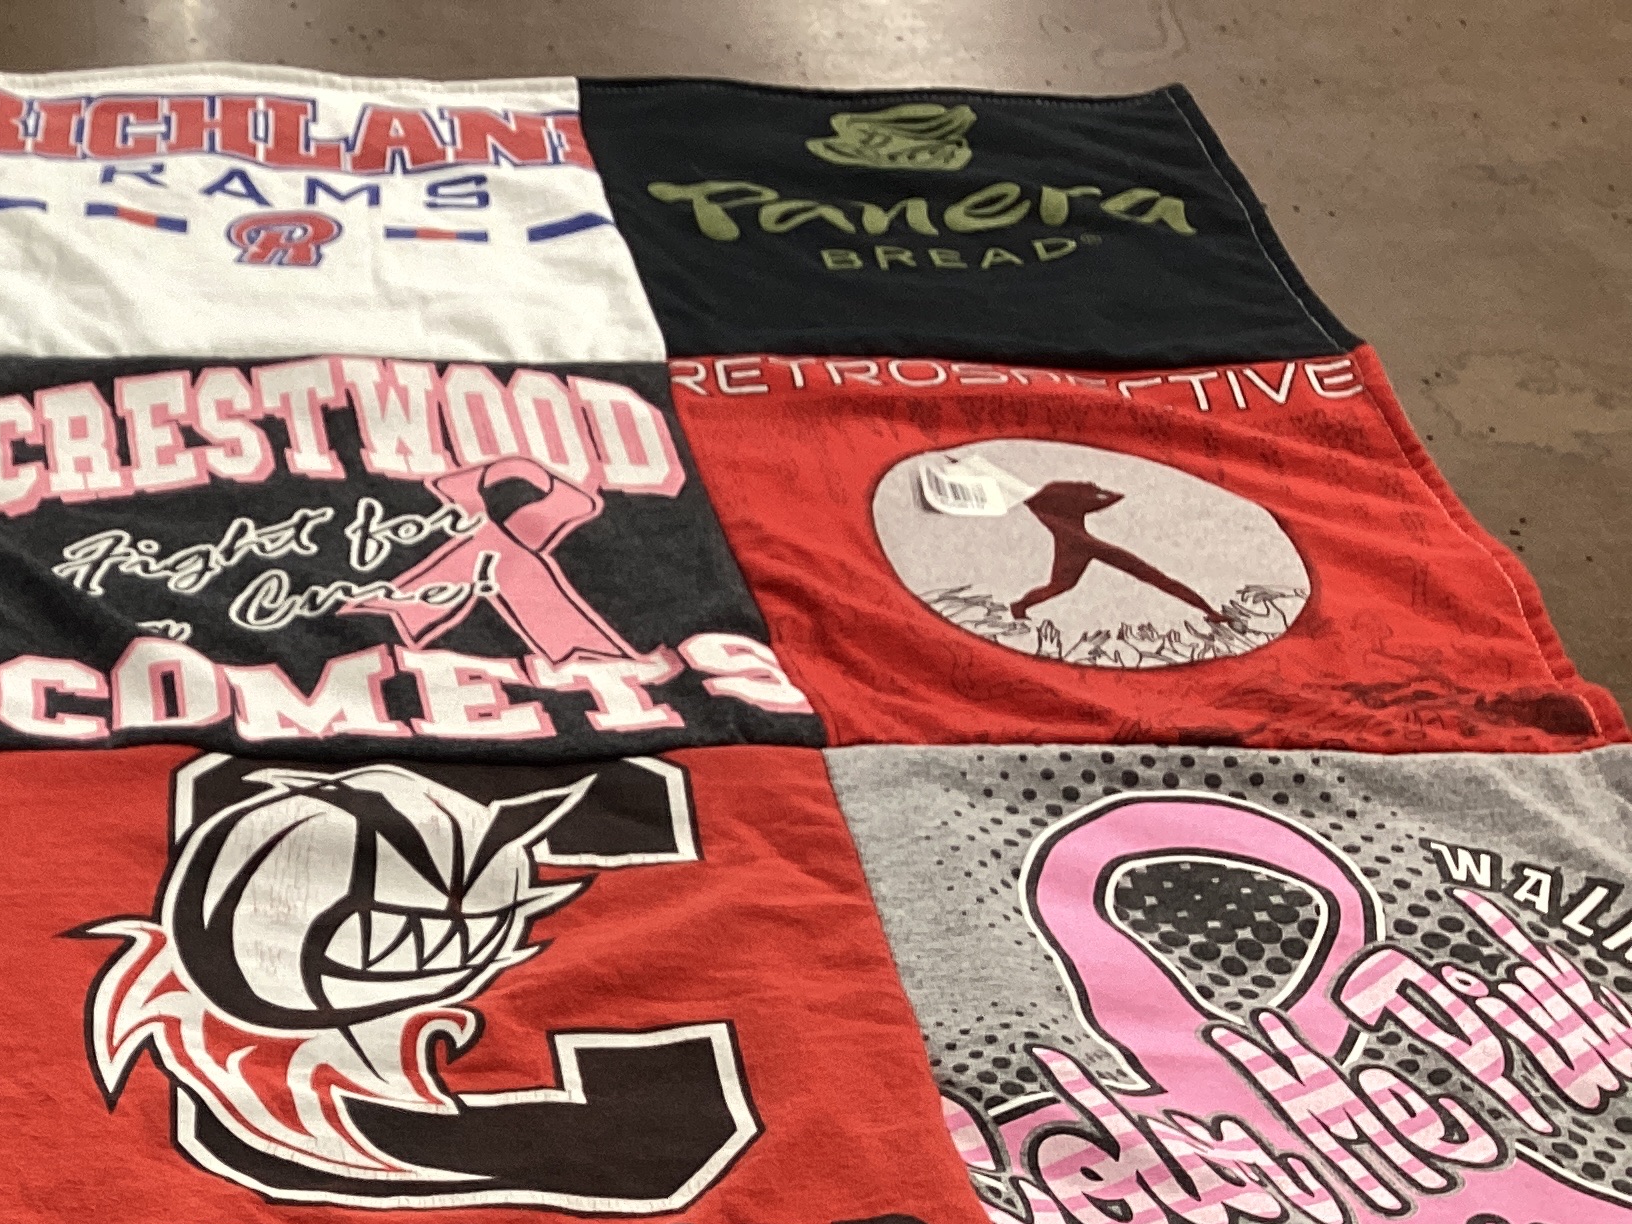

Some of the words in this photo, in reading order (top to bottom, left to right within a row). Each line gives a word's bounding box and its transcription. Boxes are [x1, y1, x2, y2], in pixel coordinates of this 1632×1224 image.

[99, 162, 489, 209] RAMS
[647, 180, 1197, 241] Panera
[820, 237, 1077, 270] BREAD
[51, 507, 334, 595] Fight
[345, 497, 488, 571] for
[1200, 1007, 1509, 1218] Me
